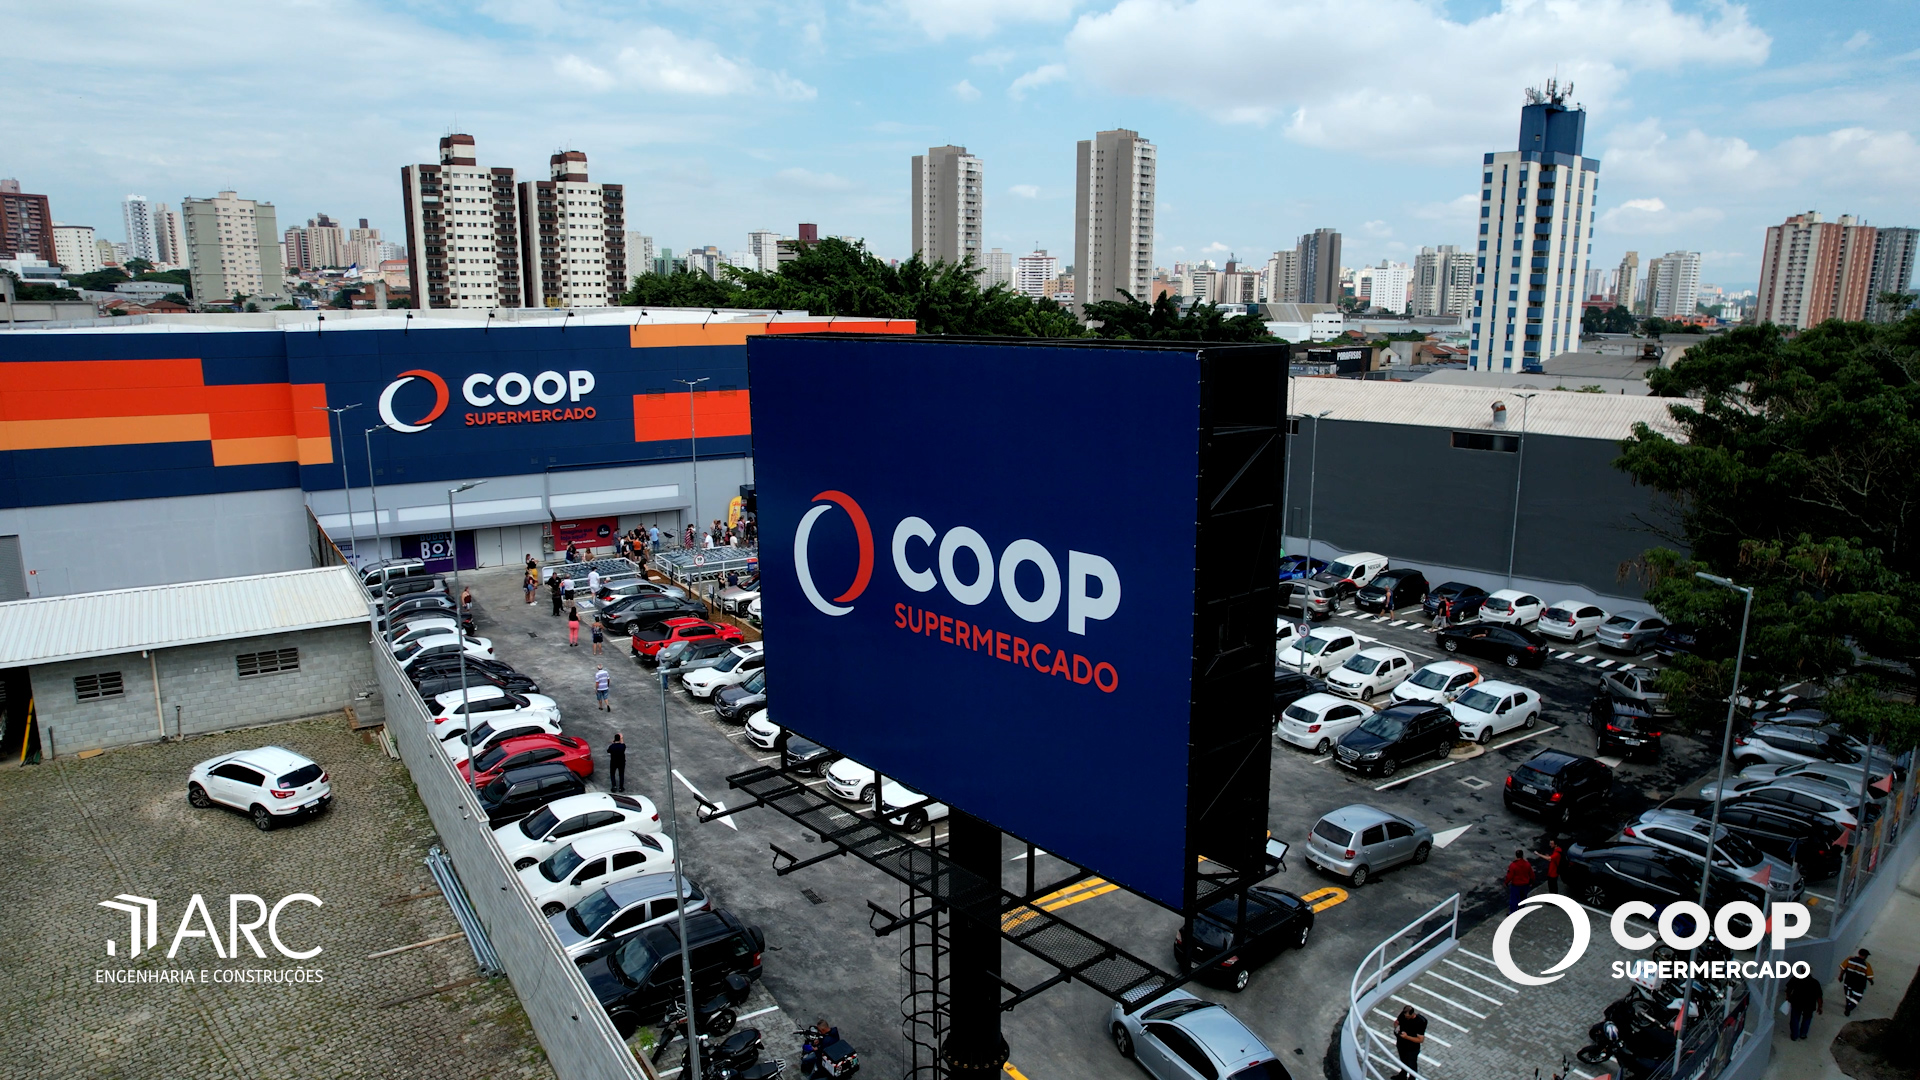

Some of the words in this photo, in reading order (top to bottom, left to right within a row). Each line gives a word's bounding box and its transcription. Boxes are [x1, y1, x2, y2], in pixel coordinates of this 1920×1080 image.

[462, 370, 596, 407] COOP
[464, 406, 597, 426] SUPERMERCADO
[892, 516, 1121, 635] COOP
[894, 602, 1119, 693] SUPERMERCADO
